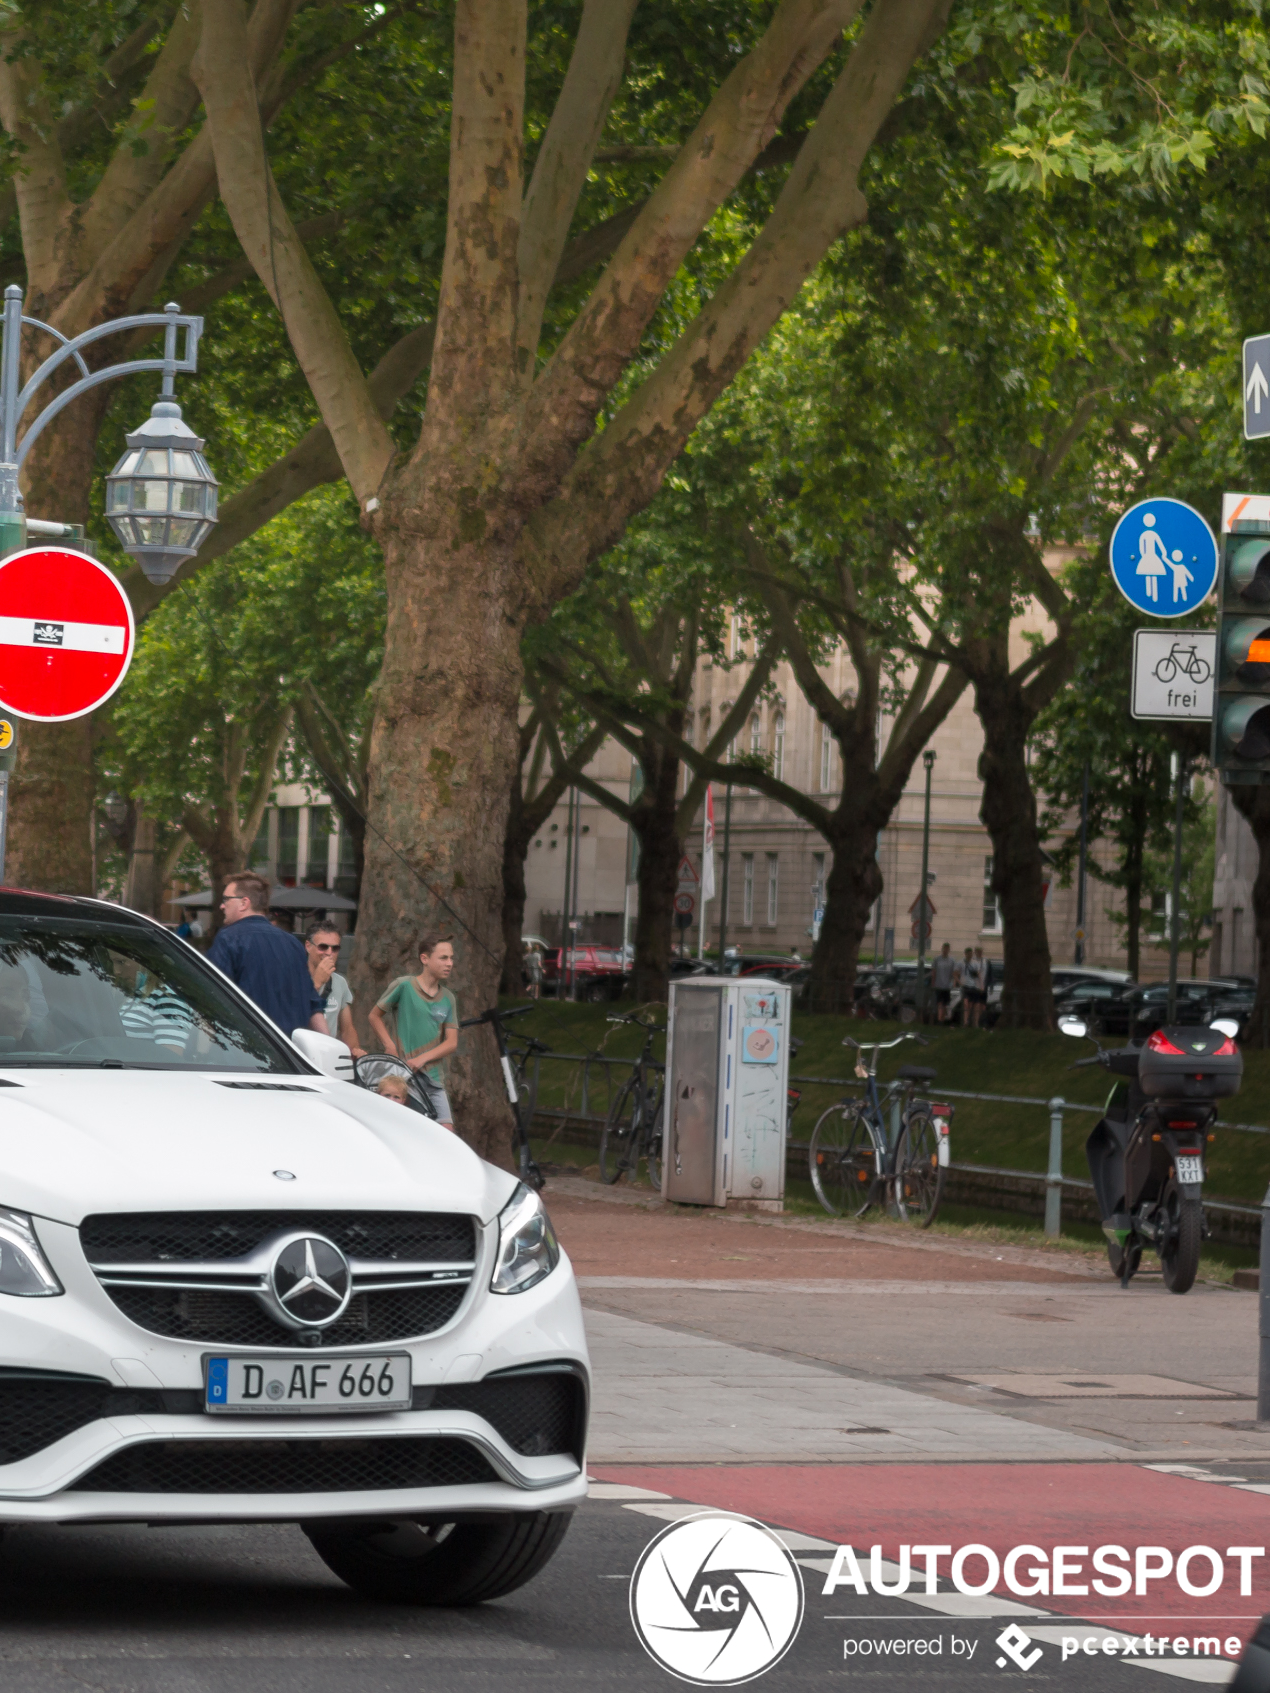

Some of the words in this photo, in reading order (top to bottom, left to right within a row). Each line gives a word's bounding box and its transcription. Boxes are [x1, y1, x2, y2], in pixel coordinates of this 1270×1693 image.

[1167, 689, 1197, 707] frei
[678, 898, 690, 909] 30
[816, 910, 824, 920] P
[1179, 1157, 1198, 1169] 531
[1180, 1170, 1199, 1181] KXT
[242, 1364, 264, 1399] D
[287, 1364, 332, 1399] AF
[338, 1361, 394, 1398] 666
[213, 1385, 222, 1397] D
